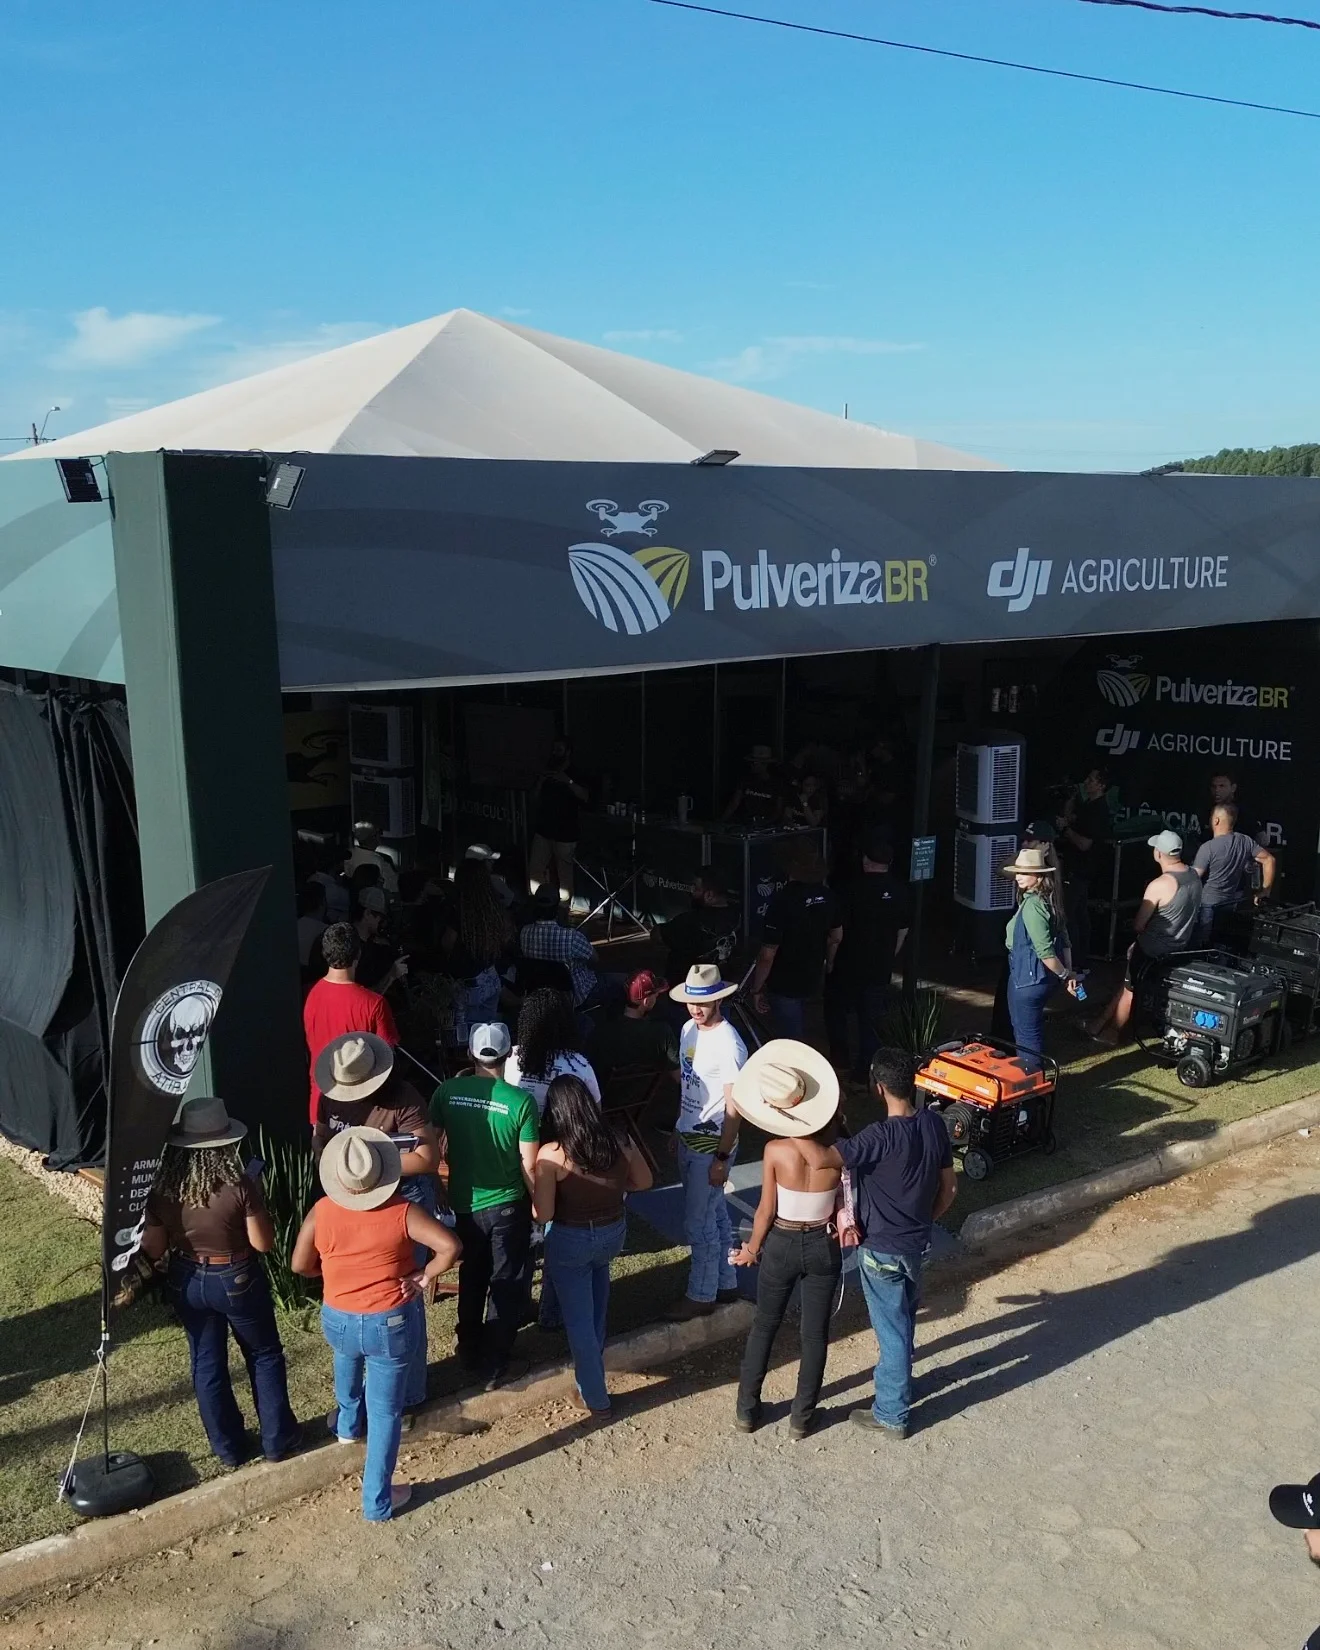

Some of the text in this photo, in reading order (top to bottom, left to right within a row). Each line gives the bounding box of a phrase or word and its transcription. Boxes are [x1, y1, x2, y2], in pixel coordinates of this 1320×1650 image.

[1061, 555, 1229, 595] AGRICULTURE
[1147, 733, 1293, 761] AGRICULTURE
[154, 982, 213, 1014] CENTRAL
[130, 1187, 151, 1199] DES
[131, 1173, 154, 1185] MUN
